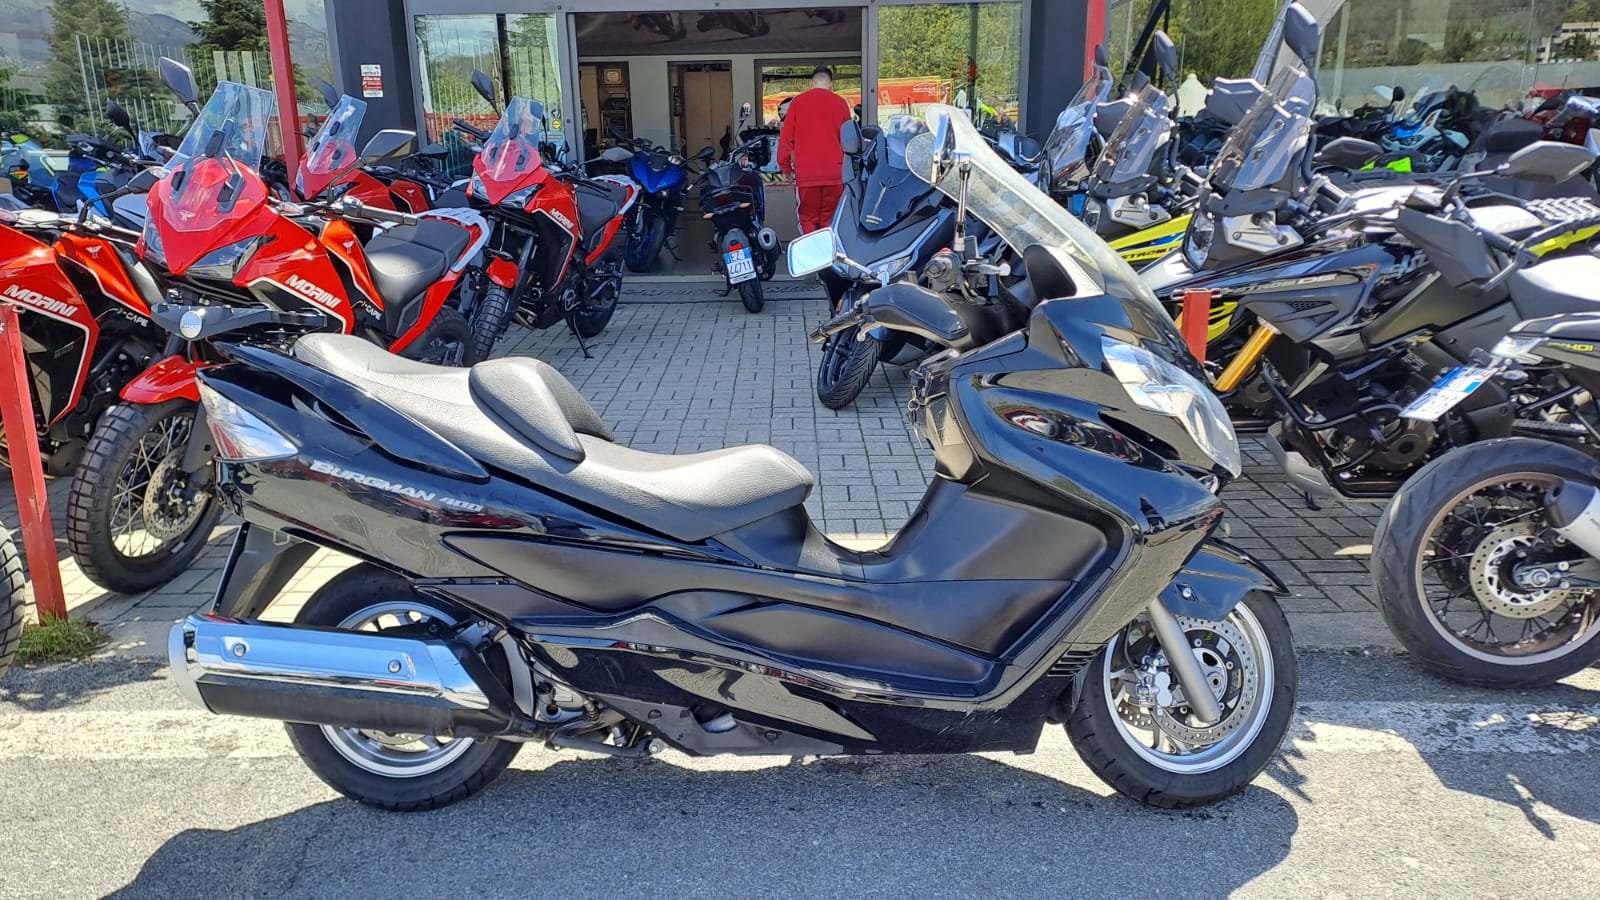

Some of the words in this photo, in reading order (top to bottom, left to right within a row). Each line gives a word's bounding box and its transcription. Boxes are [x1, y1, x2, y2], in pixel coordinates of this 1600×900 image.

[1121, 248, 1167, 259] STROM
[1391, 256, 1430, 279] SUZ
[3, 284, 78, 317] MORINI
[285, 274, 341, 308] MORINI
[310, 460, 435, 501] BURGMAN
[440, 497, 483, 512] 400
